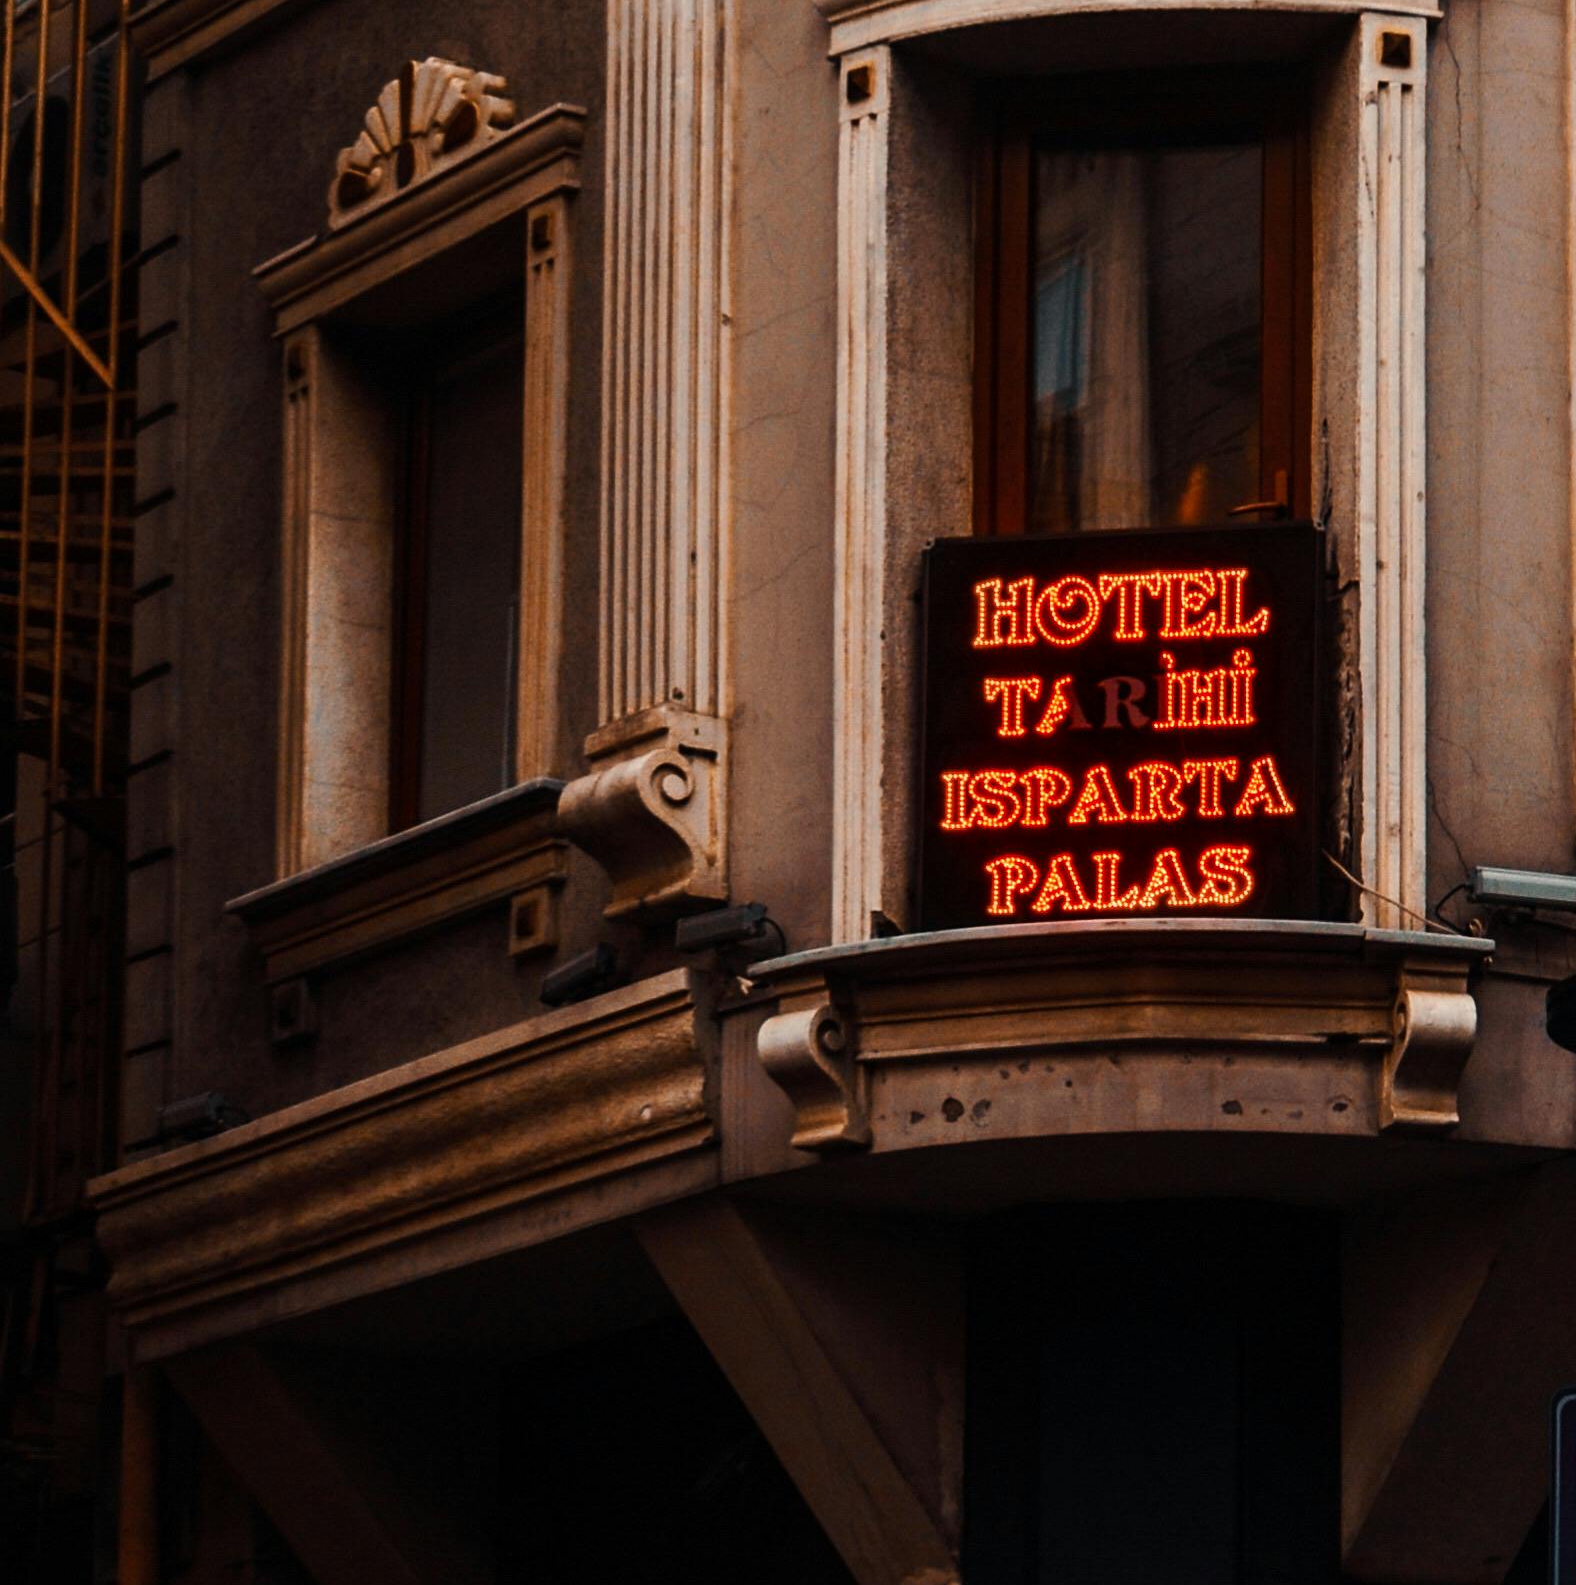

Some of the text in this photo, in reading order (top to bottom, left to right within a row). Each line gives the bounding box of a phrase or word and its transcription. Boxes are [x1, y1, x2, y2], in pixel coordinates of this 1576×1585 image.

[972, 568, 1271, 647] HOTEL
[941, 757, 1295, 830] ISPARTA
[985, 847, 1254, 915] PALAS
